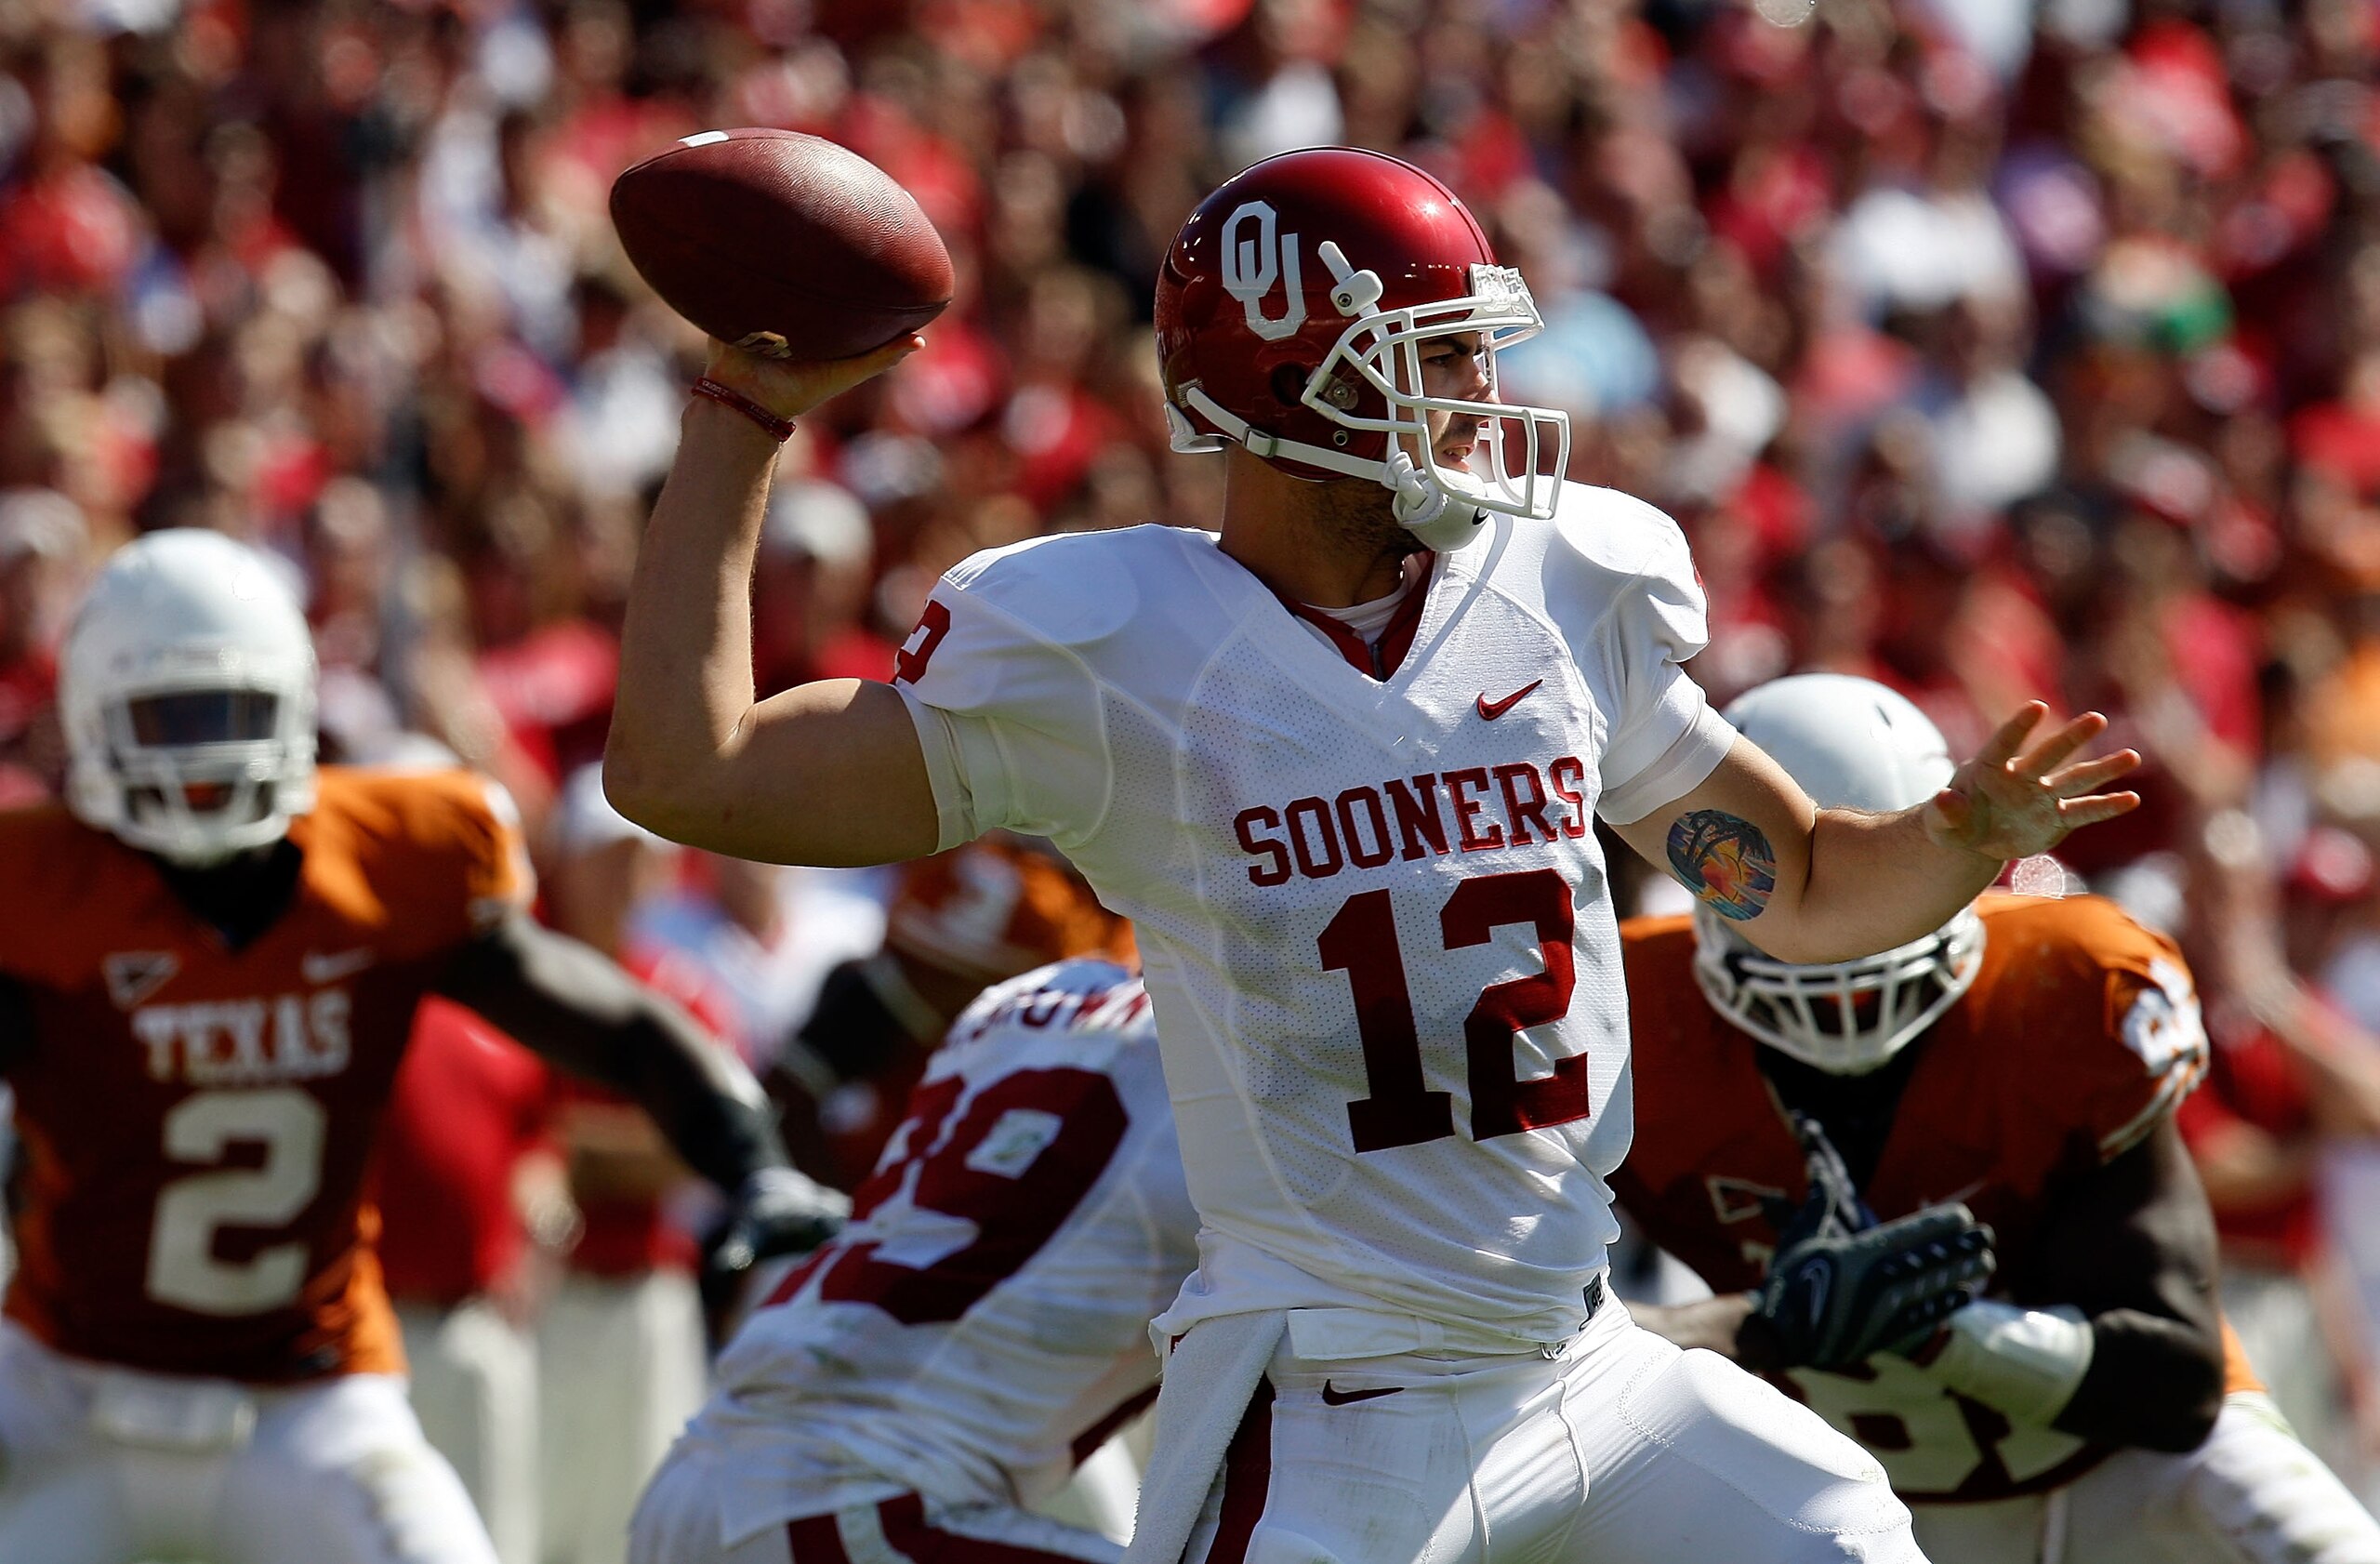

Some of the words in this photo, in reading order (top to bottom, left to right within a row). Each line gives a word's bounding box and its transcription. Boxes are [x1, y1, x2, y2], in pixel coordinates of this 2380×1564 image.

[1222, 200, 1307, 341] OU
[1233, 756, 1585, 887] SOONERS
[132, 988, 352, 1083] TEXAS
[1317, 868, 1591, 1154] 12
[145, 1087, 325, 1316] 2
